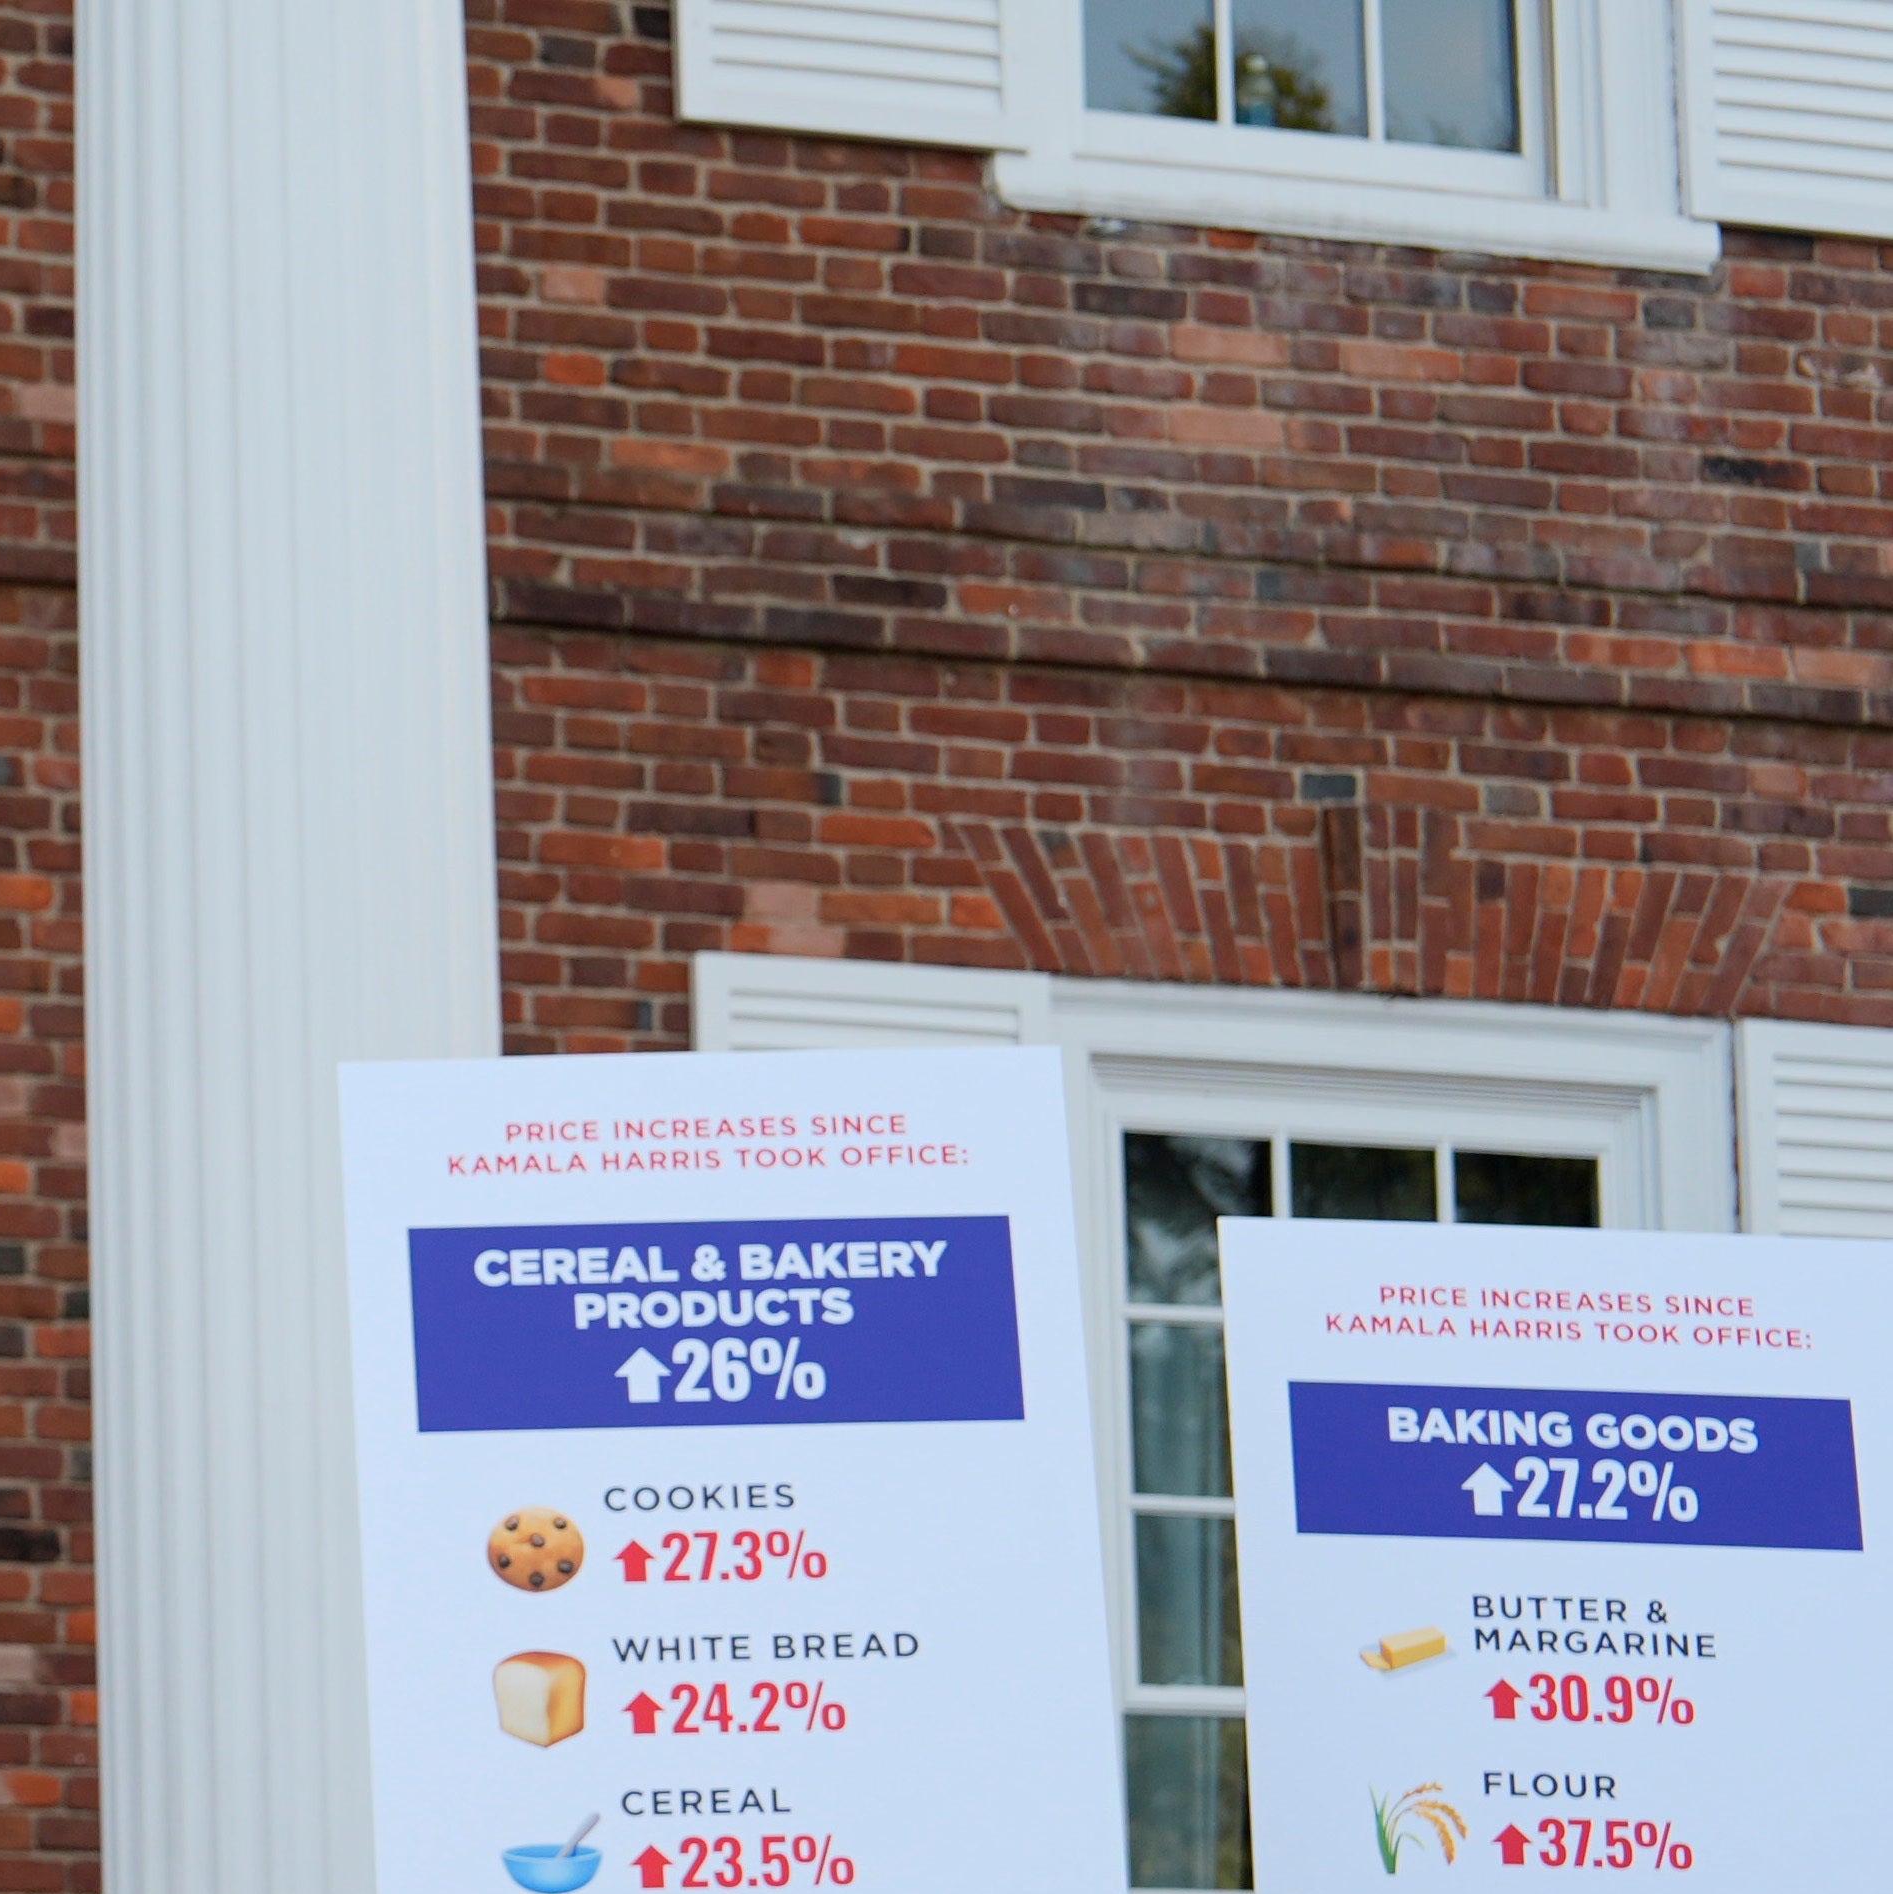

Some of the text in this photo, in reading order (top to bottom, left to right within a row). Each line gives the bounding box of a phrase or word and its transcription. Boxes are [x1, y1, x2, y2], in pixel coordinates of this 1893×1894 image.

[505, 1114, 907, 1143] PRICE INCREASES SINCE
[448, 1144, 970, 1176] KAMALA HARRIS TOOK OFFICE:
[473, 1240, 948, 1287] CEREAL & BAKERY
[574, 1287, 854, 1330] PRODUCTS
[1379, 1285, 1755, 1318] PRICE INCREASES SINCE
[1326, 1313, 1813, 1350] KAMALA HARRIS TOOK OFFICE:
[671, 1336, 826, 1403] 26%
[1387, 1406, 1759, 1455] BAKING GOODS
[604, 1484, 795, 1512] COOKIES
[1514, 1457, 1698, 1523] 27.2%
[661, 1529, 827, 1582] 27.3%
[1472, 1595, 1668, 1624] BUTTER &
[612, 1632, 920, 1662] WHITE BREAD
[1474, 1628, 1716, 1658] MARGARINE
[670, 1681, 846, 1735] 24.2%
[1528, 1672, 1694, 1725] 30.9%
[621, 1788, 792, 1816] CEREAL
[1483, 1771, 1616, 1799] FLOUR
[679, 1834, 854, 1889] 23.5%
[1537, 1817, 1693, 1871] 37.5%
